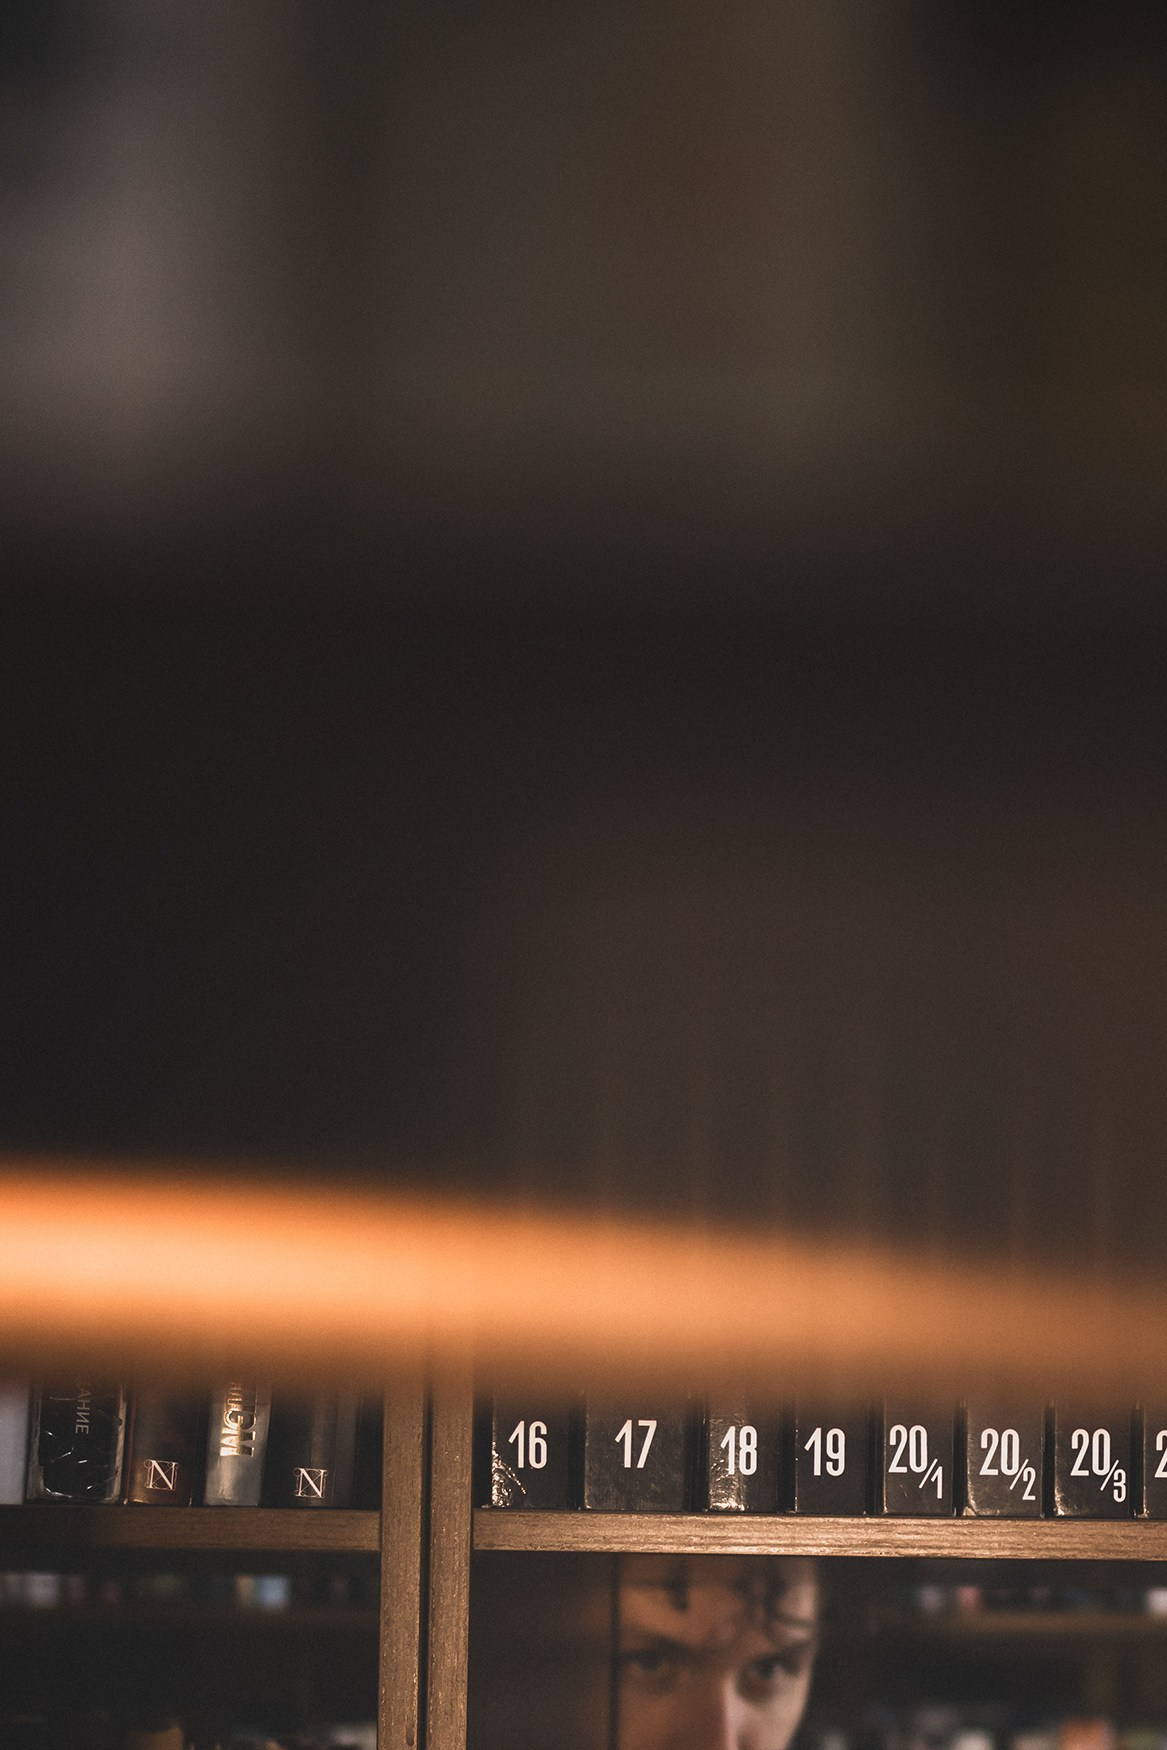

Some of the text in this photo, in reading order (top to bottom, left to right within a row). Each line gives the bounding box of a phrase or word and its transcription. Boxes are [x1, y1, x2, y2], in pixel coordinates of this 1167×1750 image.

[75, 1384, 92, 1435] АНИЕ
[508, 1420, 549, 1469] 16
[614, 1420, 657, 1469] 17
[721, 1425, 757, 1476] 18
[804, 1427, 845, 1476] 19
